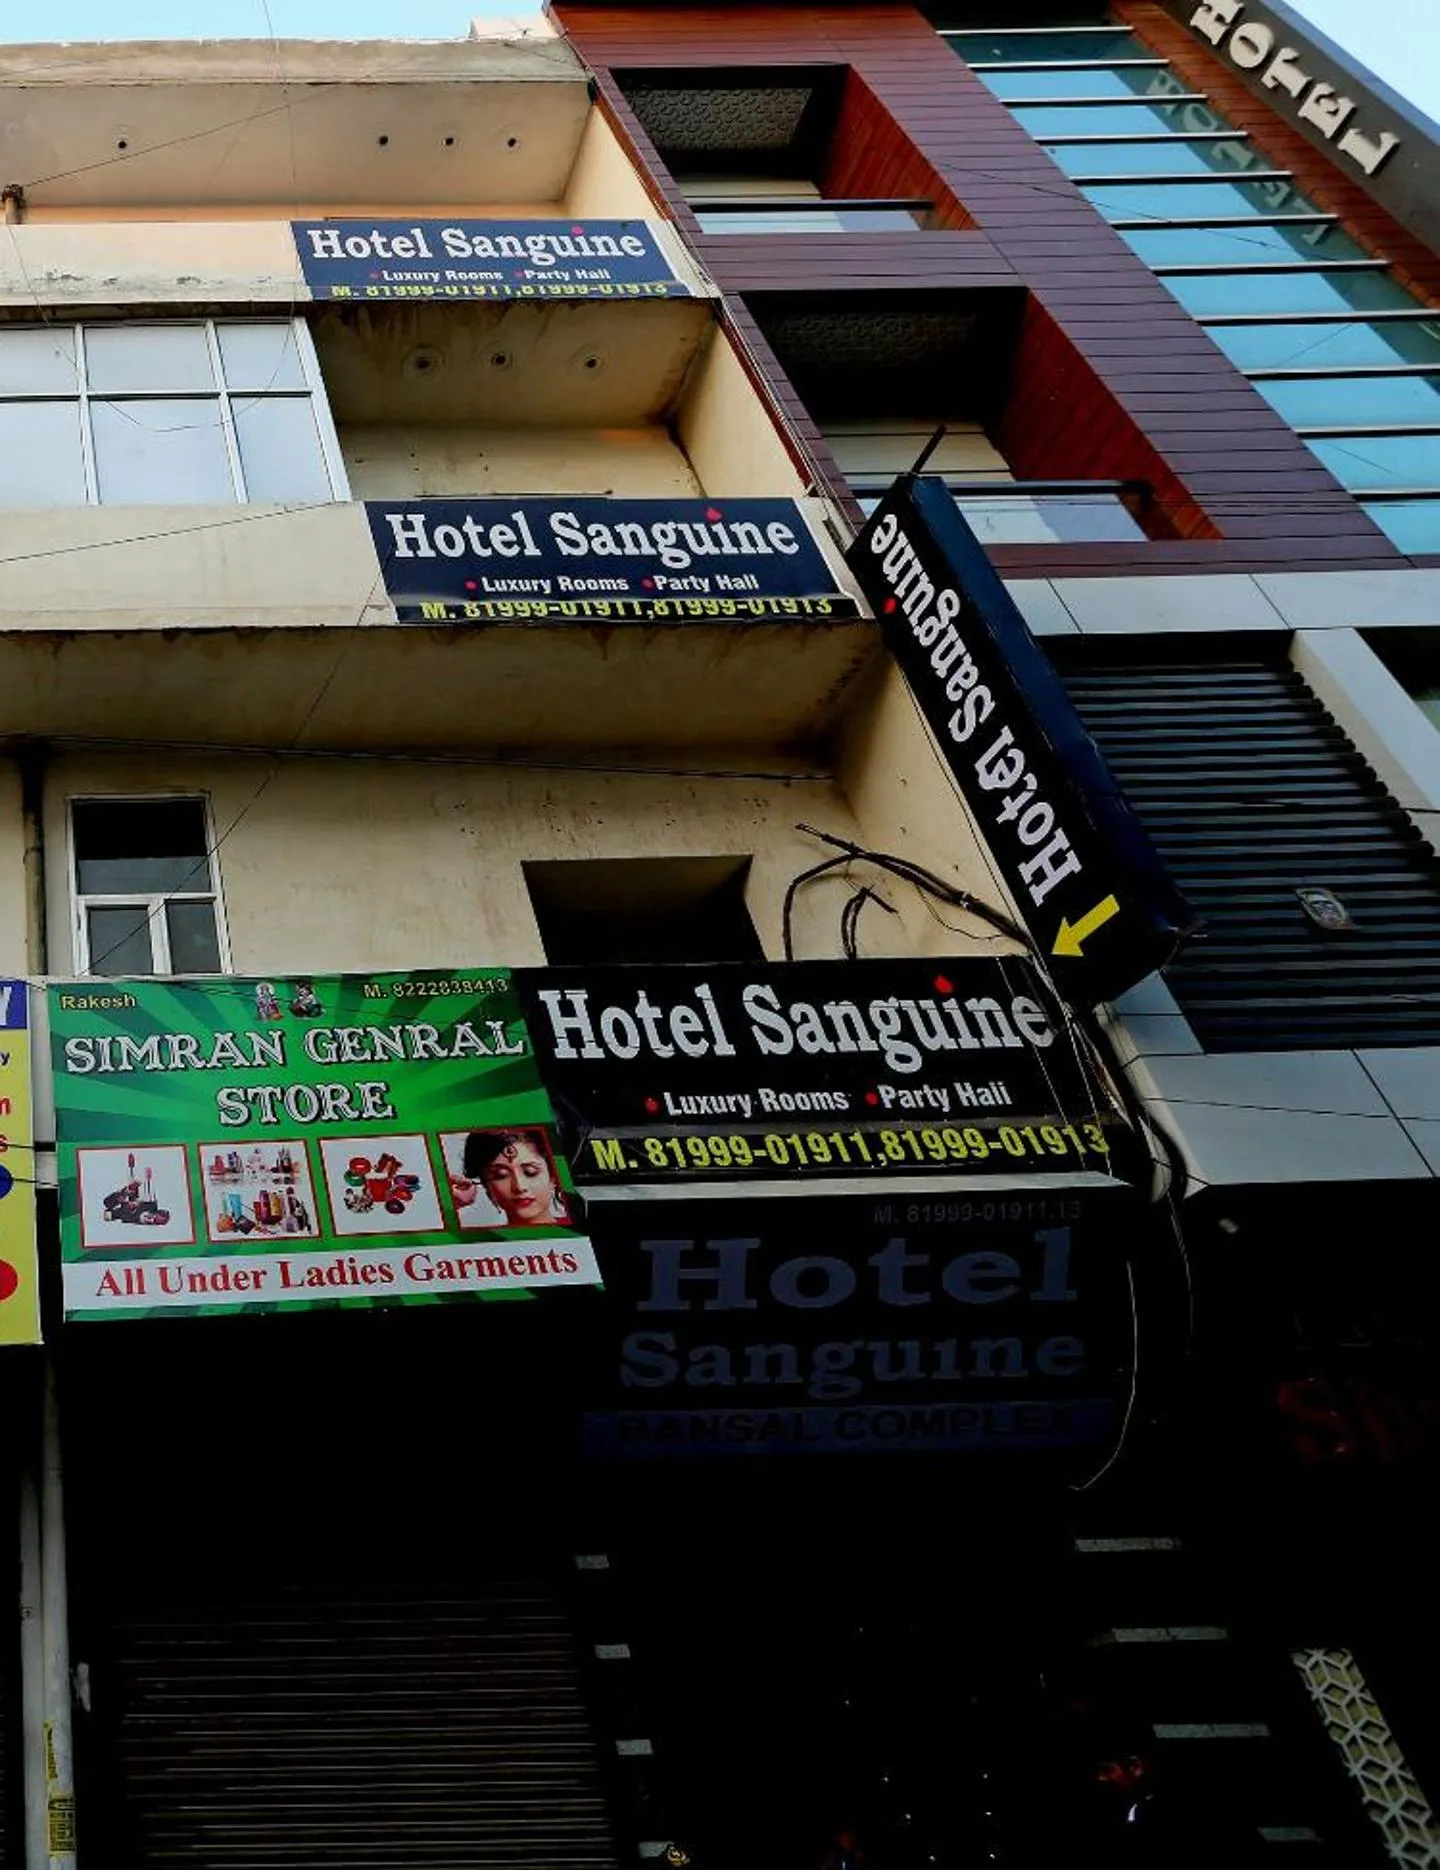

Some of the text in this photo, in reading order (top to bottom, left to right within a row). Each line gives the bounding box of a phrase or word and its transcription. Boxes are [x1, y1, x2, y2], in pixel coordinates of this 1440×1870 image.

[1190, 0, 1401, 175] HOTEL
[308, 226, 647, 265] Hotel Sanguine
[382, 268, 611, 283] Luxury Rooms Party Hall
[385, 508, 800, 569] Hotel Sanguine
[482, 573, 760, 593] Luxury Rooms Party Hall
[870, 513, 1082, 907] Hotel Sanguine
[60, 993, 137, 1010] Rakesh
[364, 983, 388, 999] M.
[65, 1020, 528, 1075] SIMRAN GENRAL
[537, 983, 1056, 1073] Hotel Sanguine
[216, 1081, 396, 1128] STORE
[663, 1081, 1013, 1119] Luxury Rooms Party Hall
[592, 1123, 1112, 1172] M. 81999-01911,81999-01913
[95, 1247, 579, 1298] All Under Ladies Garments
[635, 1225, 1079, 1312] Hotel
[618, 1329, 1088, 1400] Sanguine
